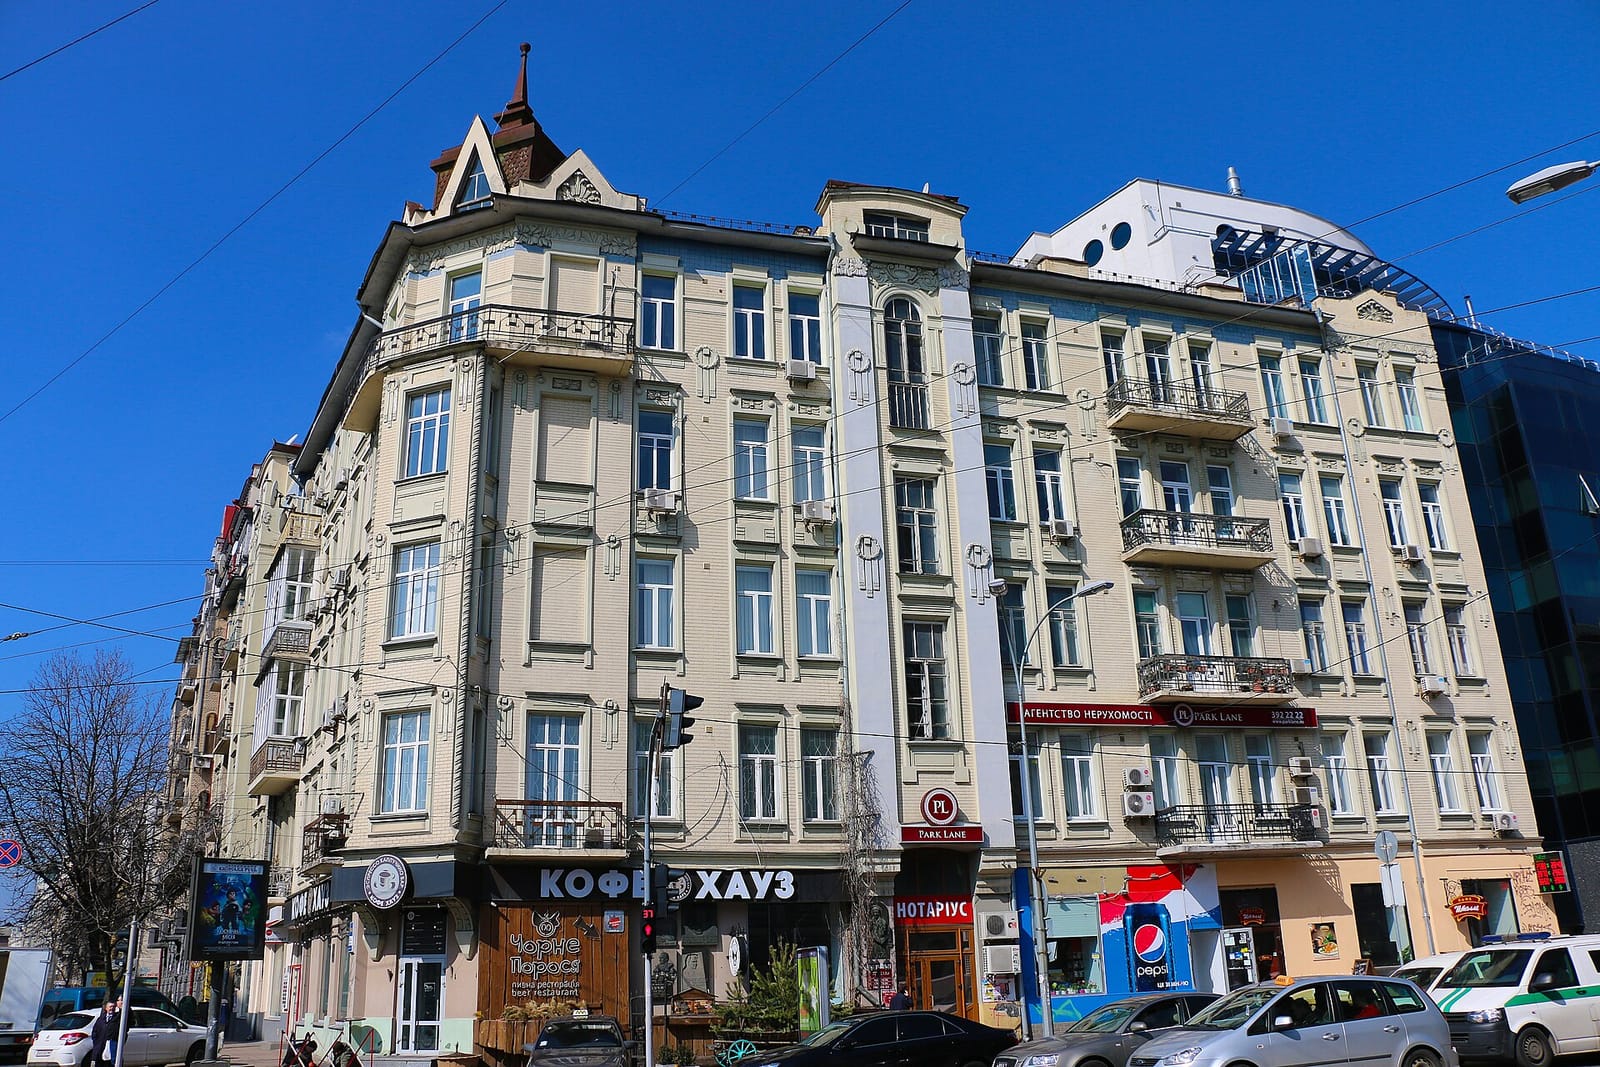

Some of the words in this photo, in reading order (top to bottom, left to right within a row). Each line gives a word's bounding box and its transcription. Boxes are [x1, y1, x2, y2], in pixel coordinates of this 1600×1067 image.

[1024, 708, 1081, 719] АГЕНТСТВО
[1083, 709, 1153, 720] НЕРУХОМОСТІ
[1271, 711, 1284, 719] 392
[1284, 711, 1294, 719] 22
[1294, 711, 1304, 719] 22
[932, 799, 950, 814] PL
[694, 870, 796, 900] ХАУЗ
[642, 909, 654, 919] 37
[896, 901, 968, 918] НОТАРІУС
[510, 933, 580, 960] Чорне
[509, 956, 581, 980] Порося
[1136, 962, 1169, 978] pepsi
[511, 988, 531, 997] beer
[534, 988, 579, 997] restaurant
